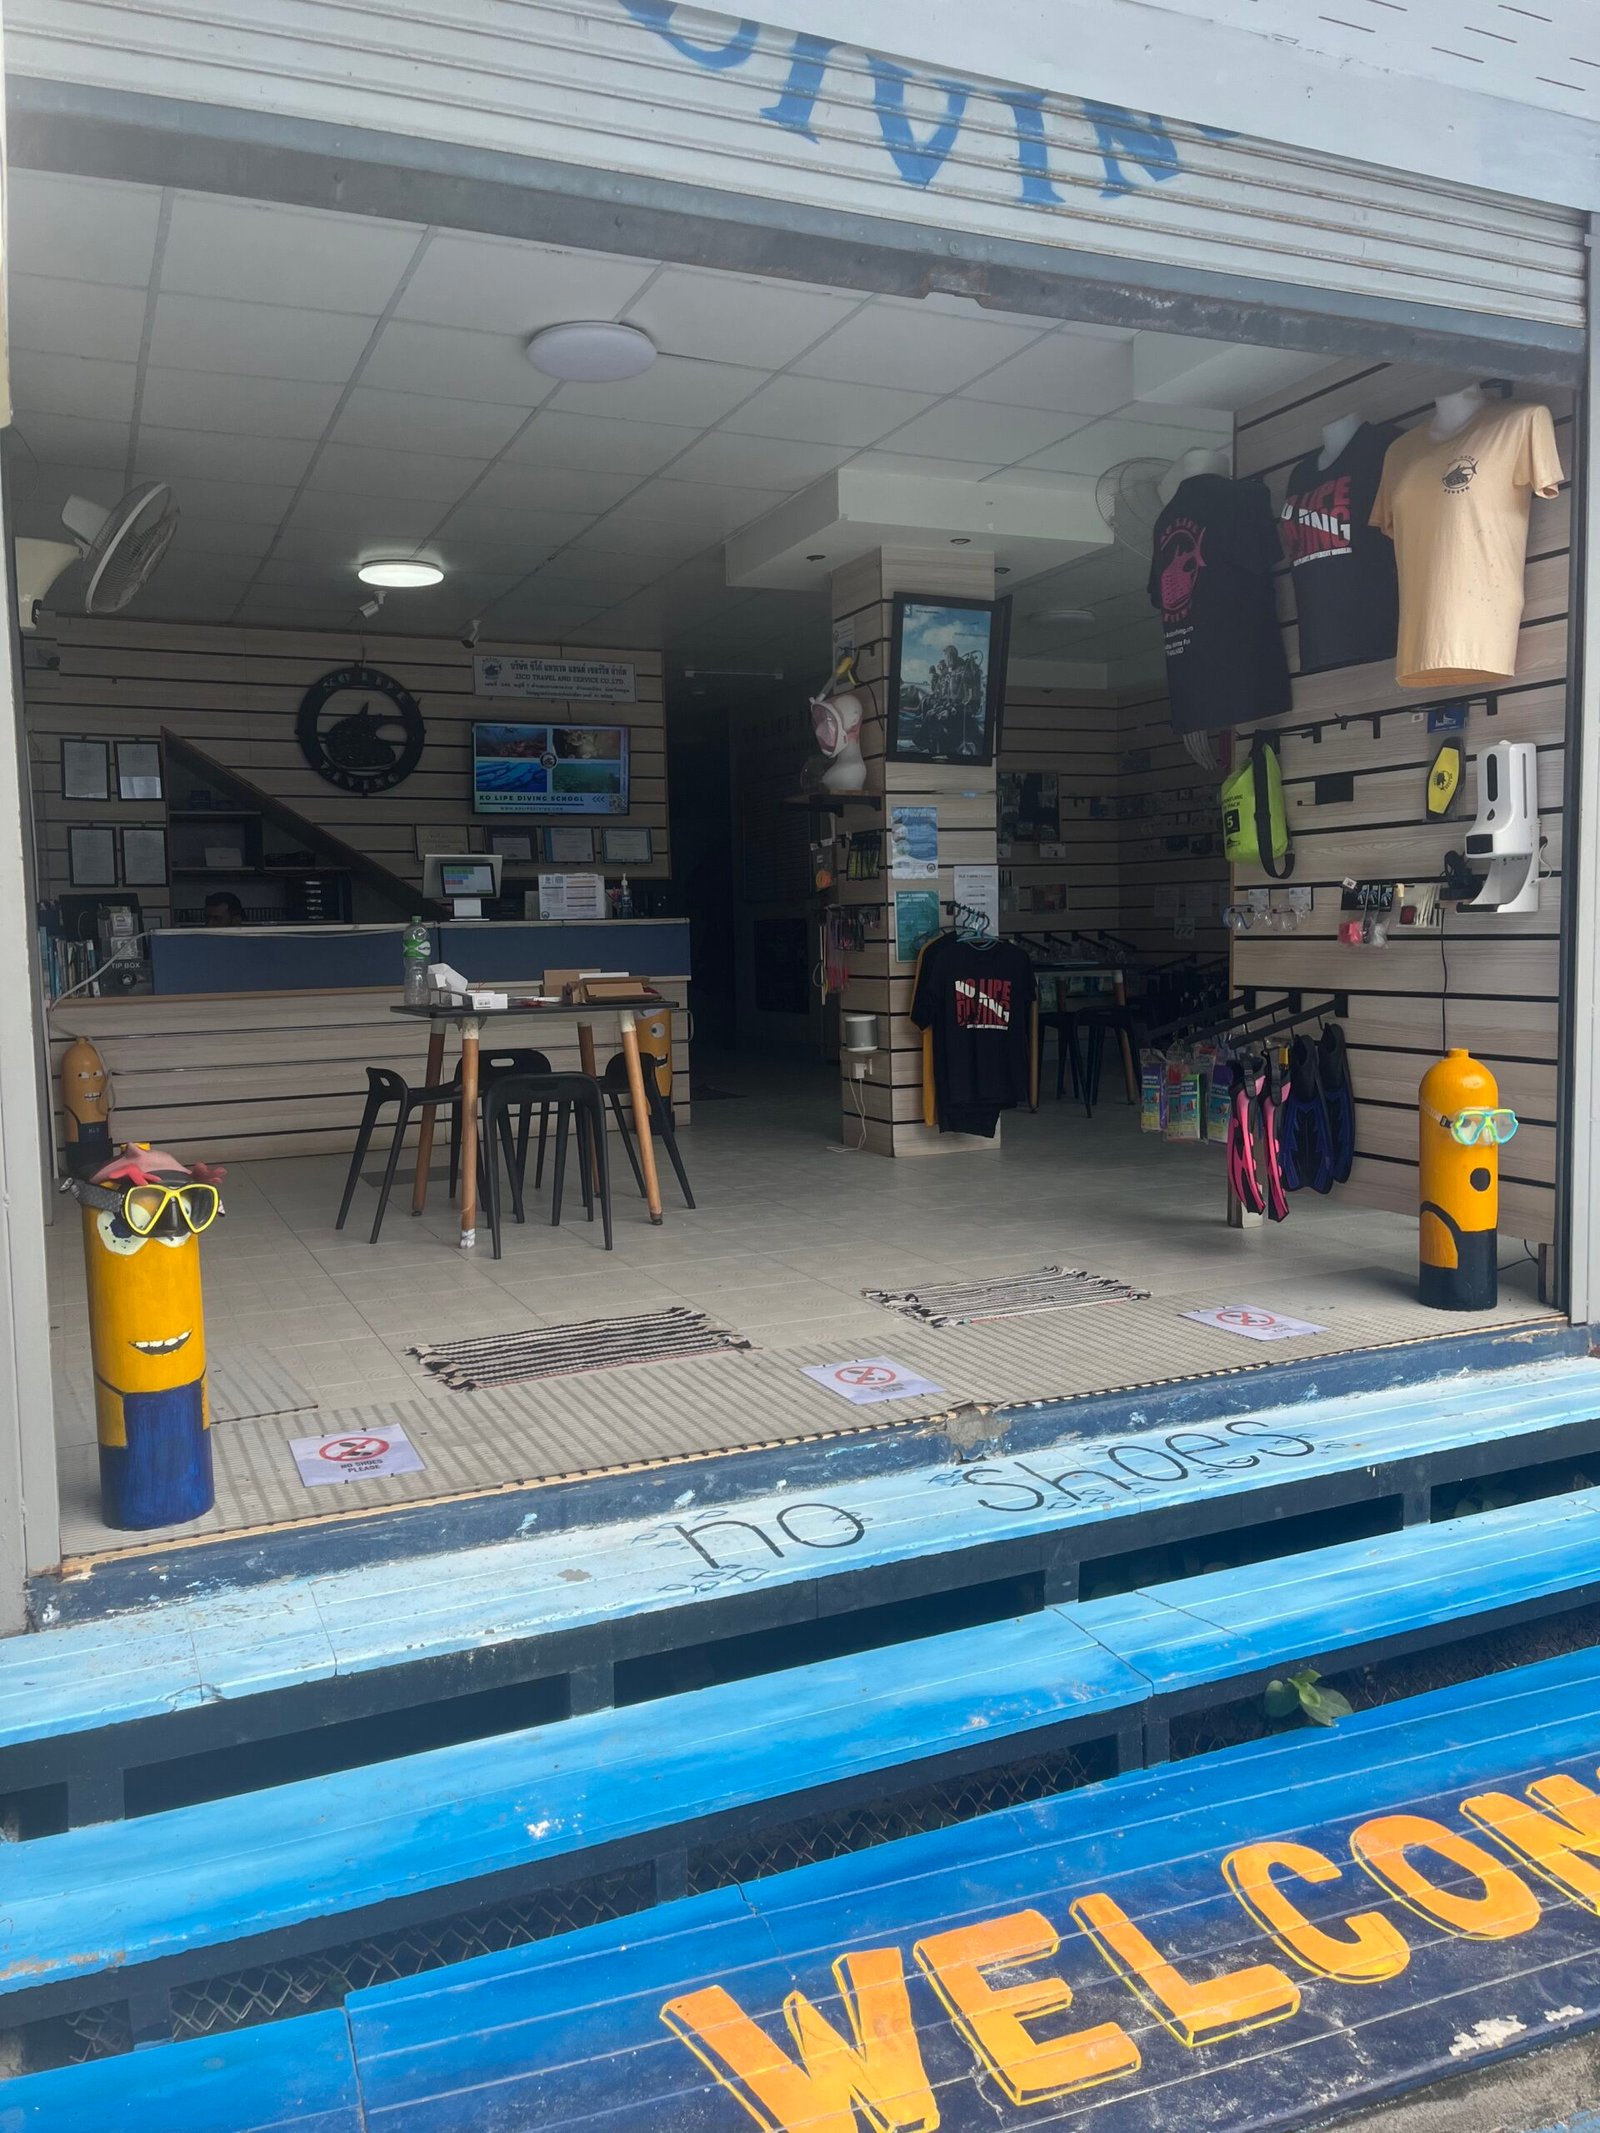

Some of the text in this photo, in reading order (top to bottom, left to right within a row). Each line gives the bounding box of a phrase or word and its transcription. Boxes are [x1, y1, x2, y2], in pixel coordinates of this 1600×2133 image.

[1226, 815, 1234, 829] 5
[978, 978, 1012, 1002] LIPE
[673, 1501, 866, 1571] no
